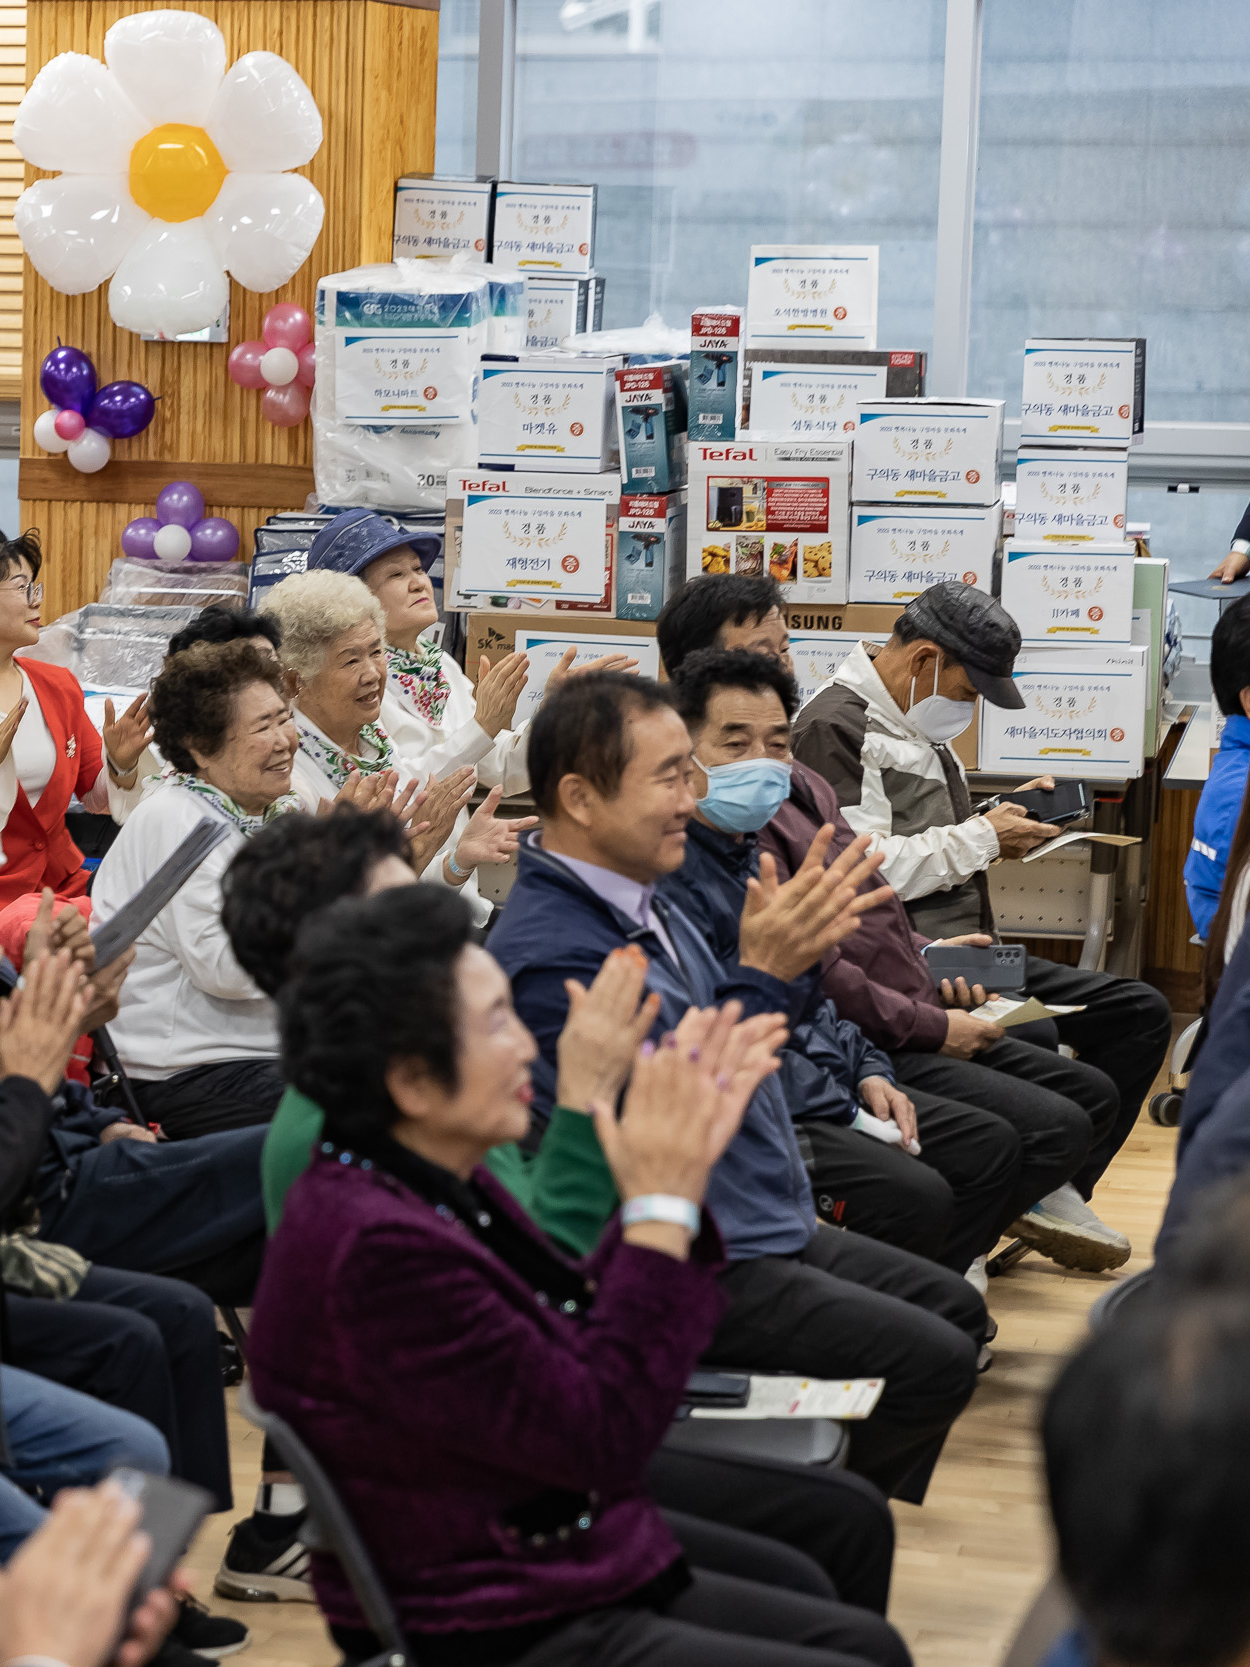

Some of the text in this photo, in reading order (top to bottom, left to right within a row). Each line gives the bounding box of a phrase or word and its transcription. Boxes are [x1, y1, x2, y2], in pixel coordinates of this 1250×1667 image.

[423, 237, 471, 250] 새마을금고
[526, 242, 575, 254] 새마을금고
[374, 388, 419, 399] 하모니마트
[1022, 403, 1055, 416] 구의동
[1057, 403, 1114, 417] 새마을금고
[522, 422, 558, 435] 마켓유
[698, 447, 758, 461] Tefal
[774, 448, 793, 457] Easy
[795, 448, 808, 458] Fry
[866, 468, 901, 482] 구의동
[904, 469, 961, 482] 새마을금고
[459, 479, 510, 493] Tefal
[1015, 512, 1048, 525] 구의동
[1051, 513, 1109, 527] 새마을금고
[505, 557, 551, 571] 재형전기
[864, 570, 899, 583] 구의동
[901, 570, 958, 583] 새마을금고
[786, 614, 842, 630] SUNG
[478, 639, 493, 649] SK
[1003, 726, 1108, 741] 새마을지도자협의회
